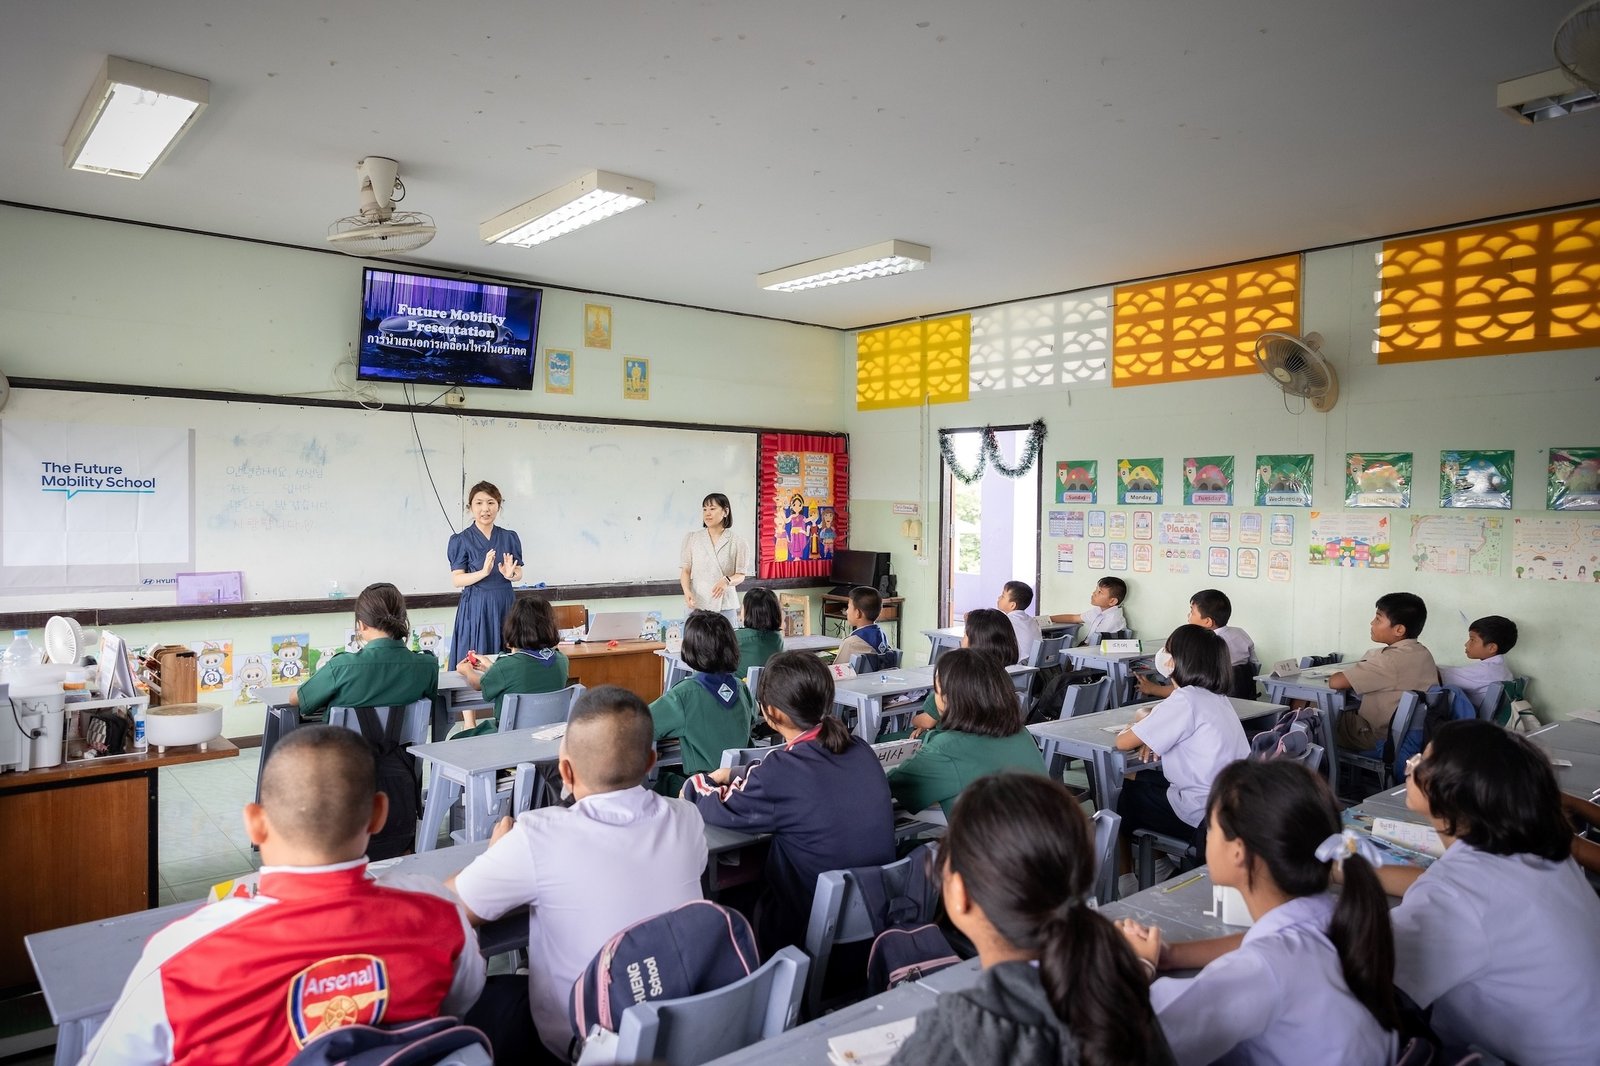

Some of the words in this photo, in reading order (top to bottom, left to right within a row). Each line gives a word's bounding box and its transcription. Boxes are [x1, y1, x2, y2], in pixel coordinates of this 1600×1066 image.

[397, 304, 448, 319] Future
[450, 309, 507, 326] Mobility
[407, 320, 496, 339] Presentation
[41, 461, 71, 473] The
[74, 463, 123, 475] Future
[41, 475, 104, 489] Mobility
[106, 476, 156, 488] School
[303, 965, 374, 997] Arsenal
[643, 956, 663, 997] School
